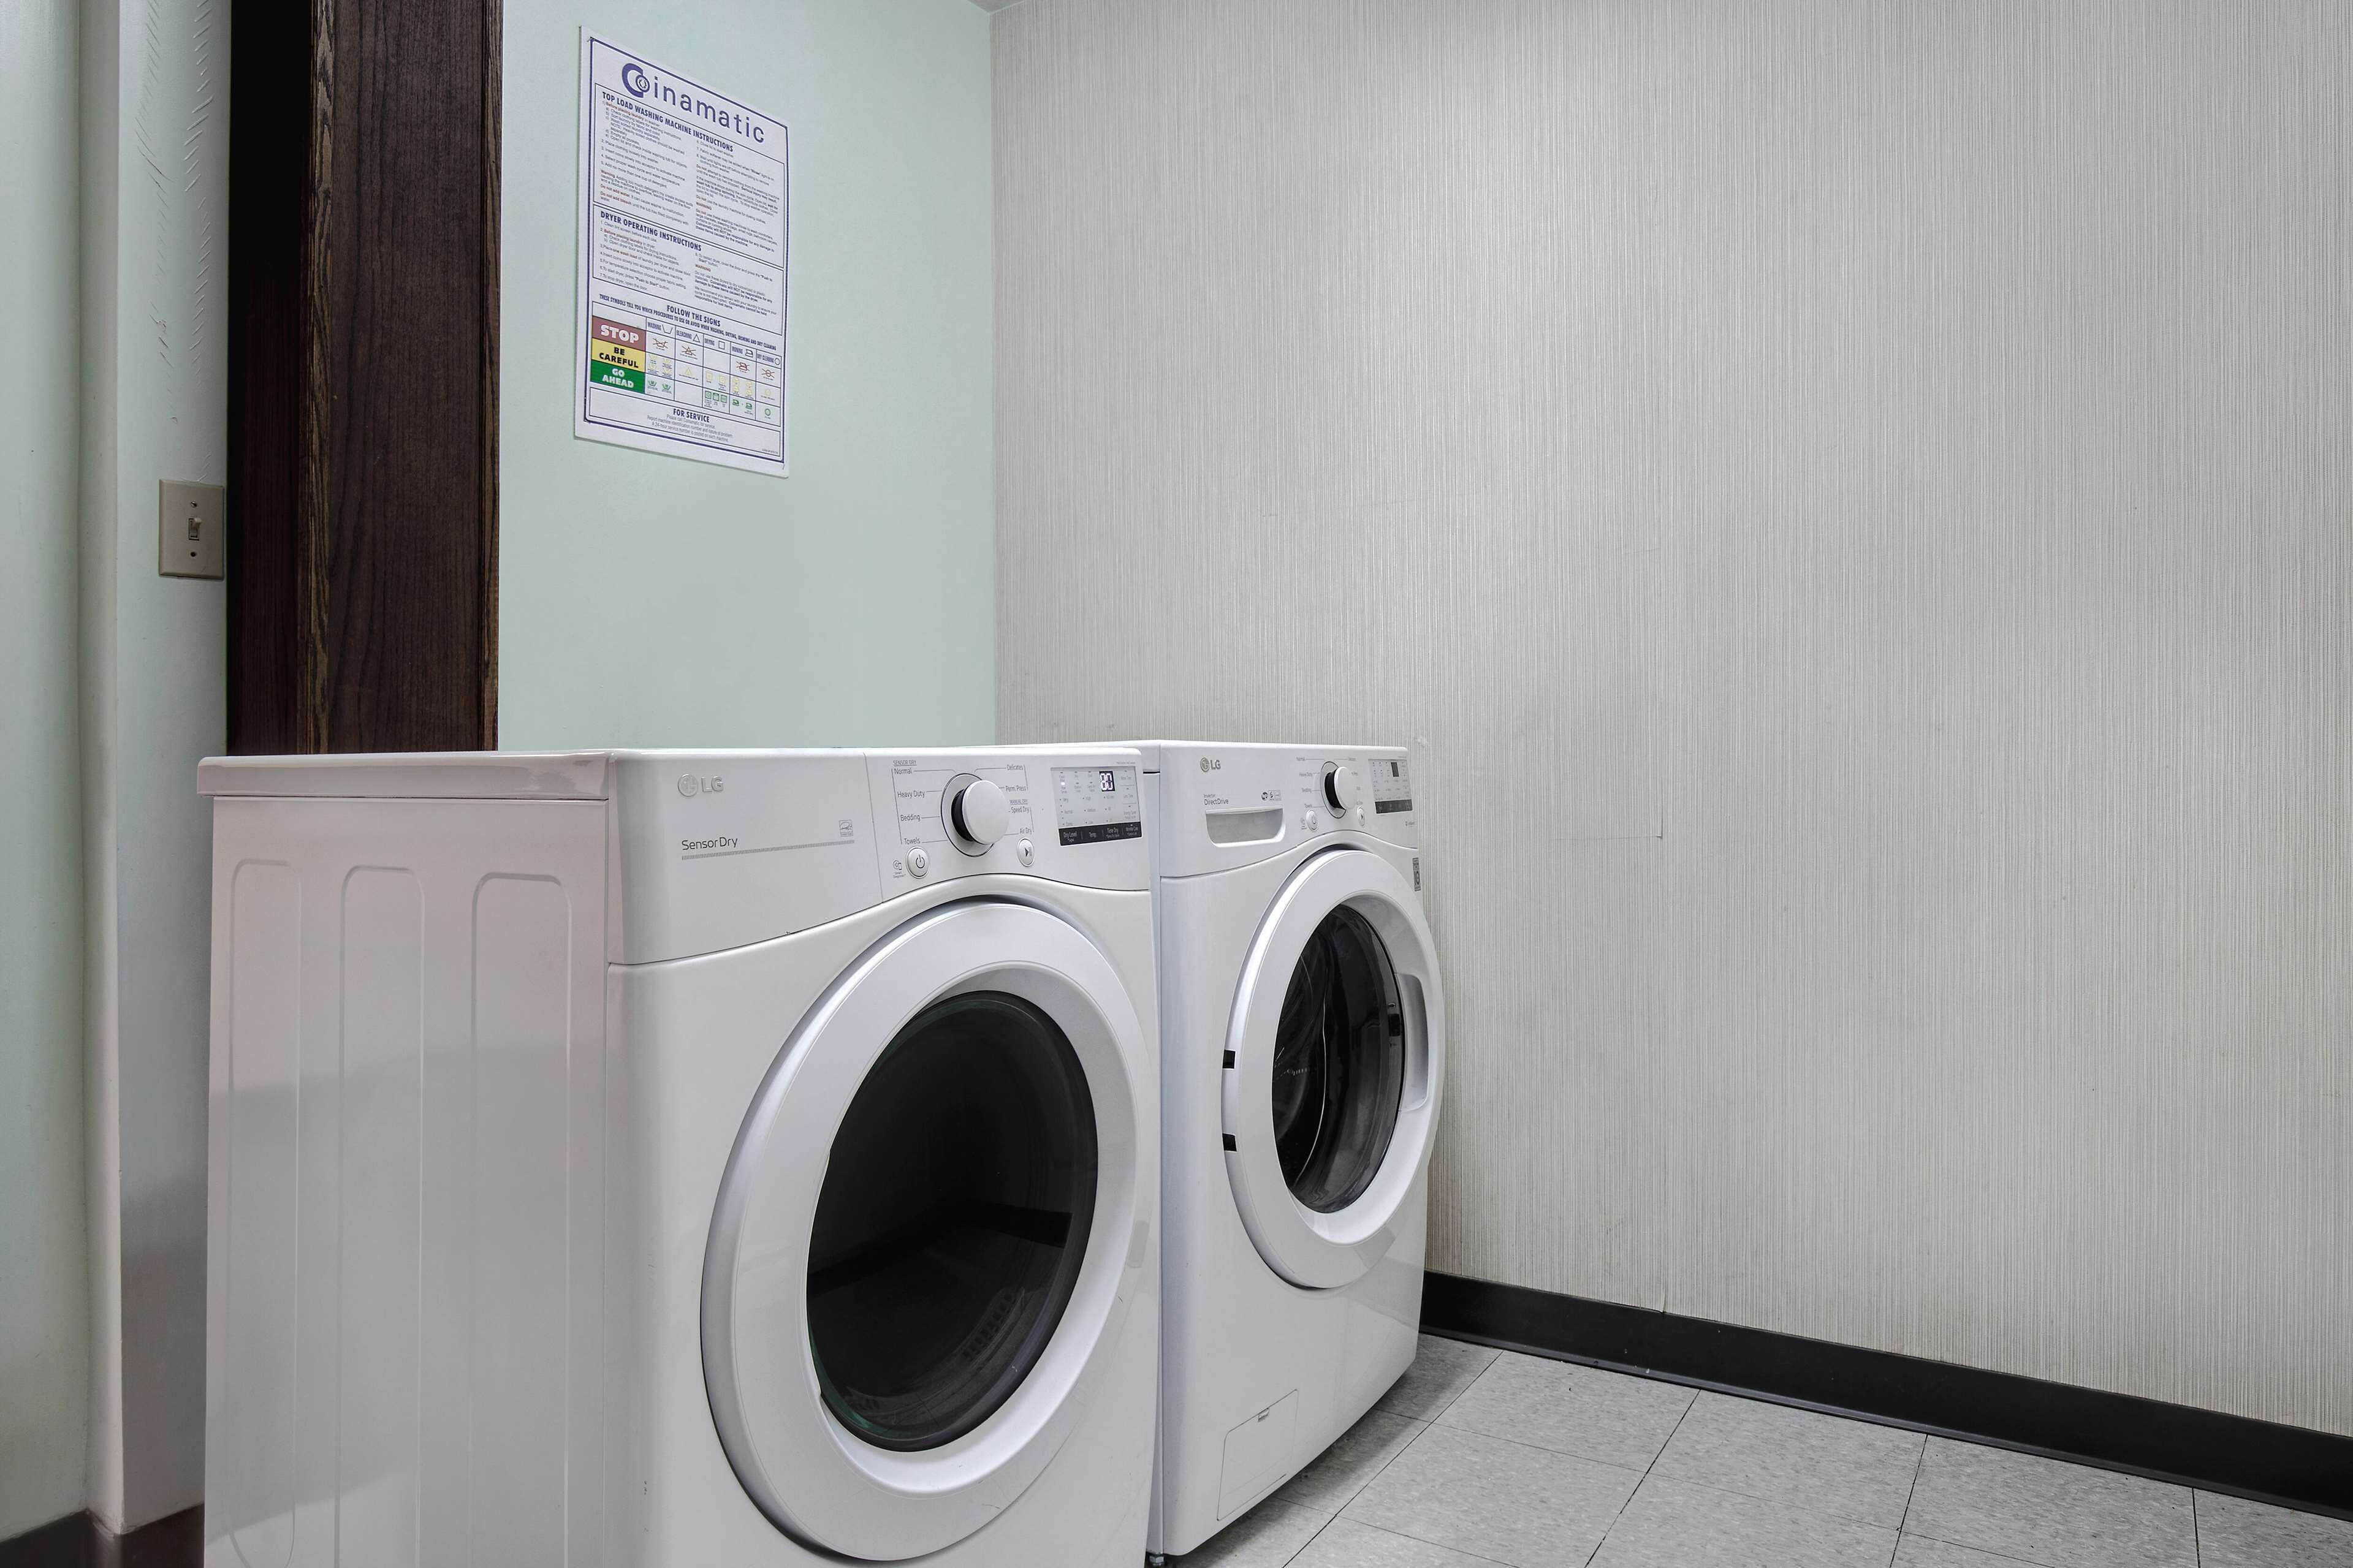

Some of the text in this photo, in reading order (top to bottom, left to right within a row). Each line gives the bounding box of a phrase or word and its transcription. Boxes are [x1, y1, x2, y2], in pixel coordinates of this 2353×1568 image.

[602, 91, 615, 103] TOP
[617, 97, 633, 110] LOAD
[634, 104, 663, 123] WASHING
[664, 117, 691, 135] MACHINE
[693, 129, 733, 153] INSTRUCTIONS
[600, 210, 622, 224] DRYER
[623, 218, 658, 237] OPERATING
[660, 230, 701, 252] INSTRUCTIONS
[599, 293, 609, 302] THESE
[610, 297, 625, 306] SYMBOLS
[642, 306, 652, 314] WHICH
[653, 309, 673, 320] PROCEDURES
[690, 320, 699, 328] AVOID
[737, 334, 750, 343] IRONING
[763, 342, 776, 350] CLEANING
[666, 305, 720, 327] FOLLOW THE SIGNS
[600, 323, 639, 345] STOP
[676, 330, 692, 339] BLEACHING
[614, 346, 625, 355] BE
[599, 352, 639, 368] CAREFUL
[612, 367, 625, 377] GO
[602, 374, 634, 389] AHEAD
[673, 408, 709, 423] FOR SERVICE
[1211, 759, 1222, 770] LG
[701, 775, 724, 793] LG
[900, 813, 921, 822] Bedding
